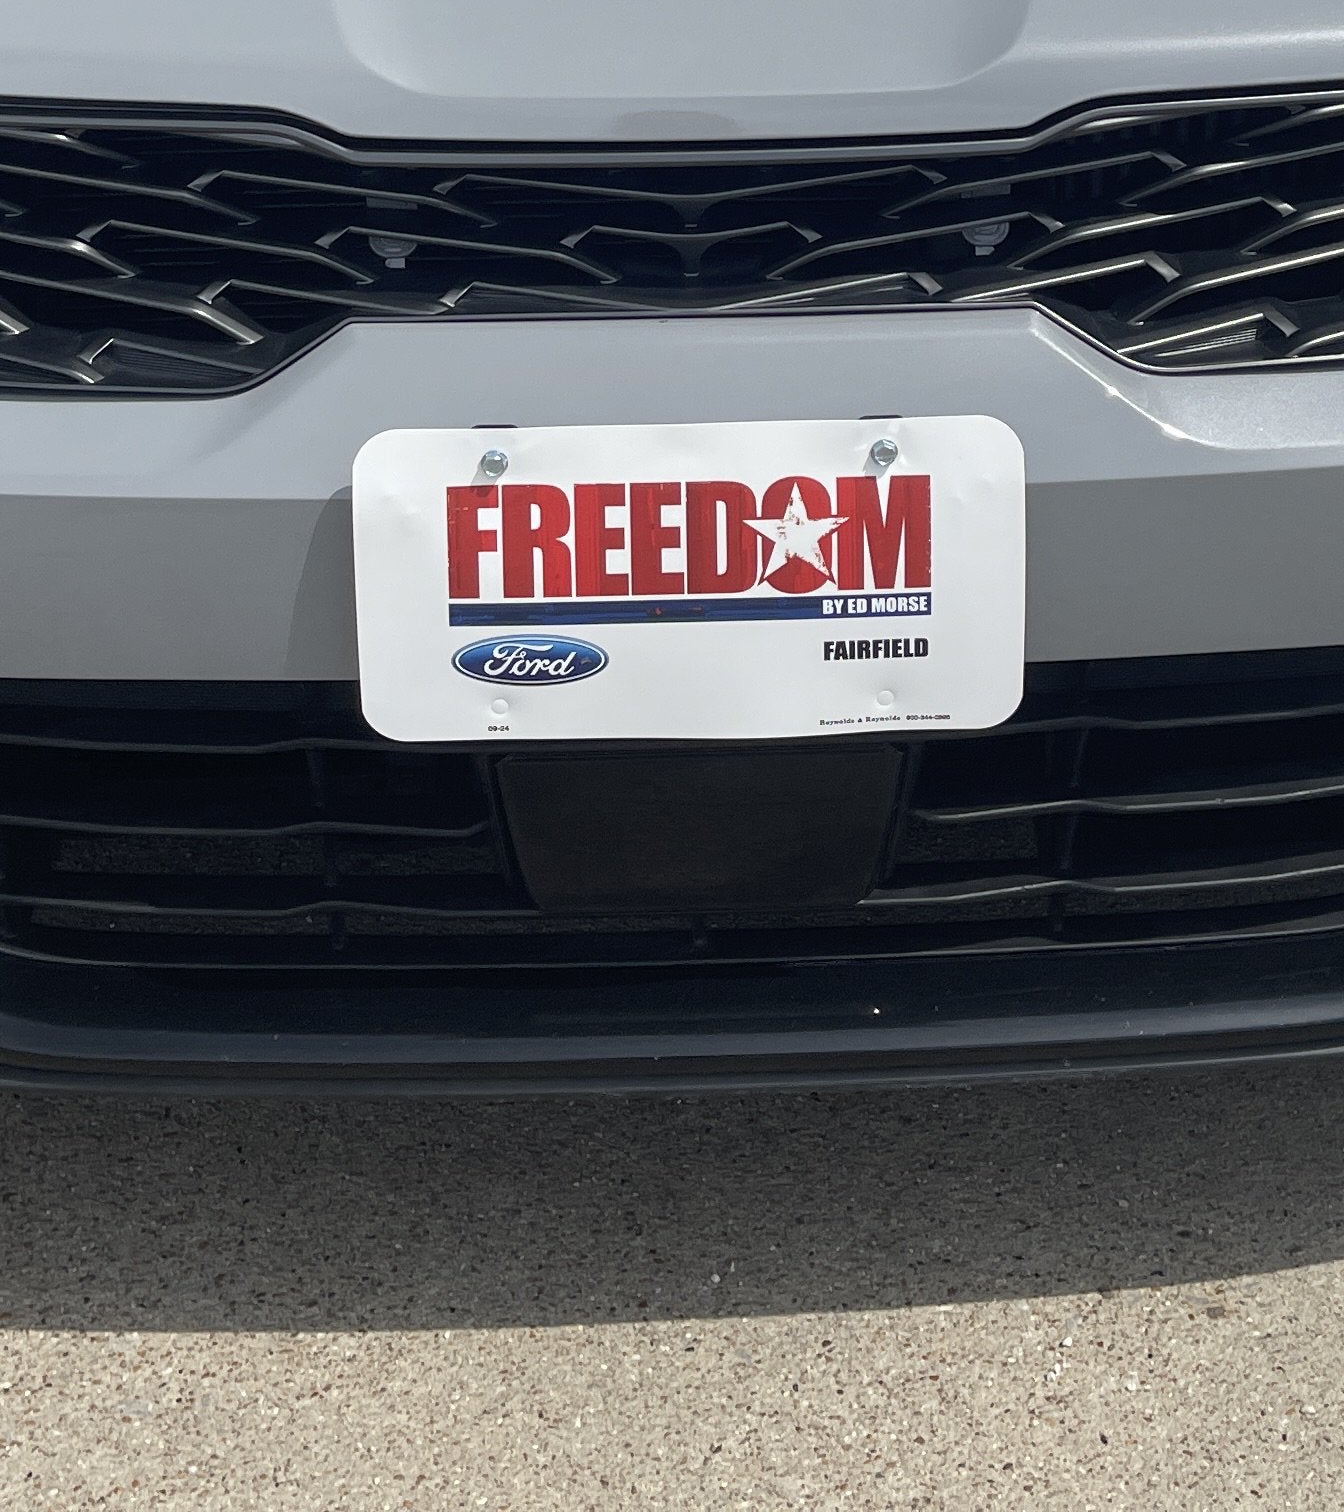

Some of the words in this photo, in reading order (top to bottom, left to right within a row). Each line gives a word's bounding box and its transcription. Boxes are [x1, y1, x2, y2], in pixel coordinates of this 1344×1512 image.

[446, 474, 933, 598] FREEDOM
[822, 599, 844, 615] BY
[847, 598, 867, 614] ED
[871, 596, 928, 613] MORSE
[484, 642, 577, 676] Ford
[823, 637, 929, 661] FAIRFIELD
[819, 718, 855, 726] Reynolds
[865, 715, 901, 723] Reynolds
